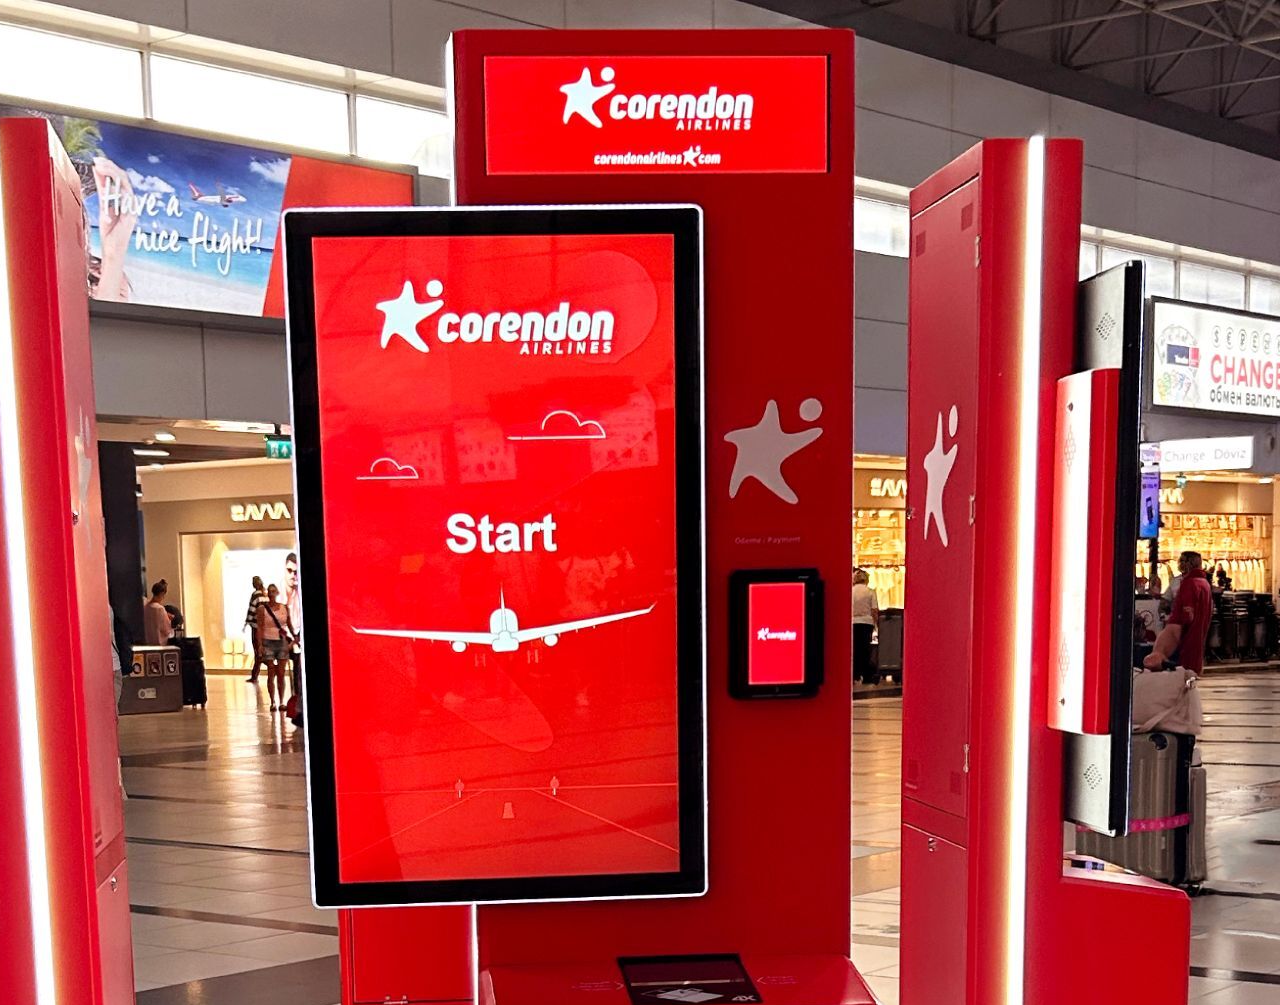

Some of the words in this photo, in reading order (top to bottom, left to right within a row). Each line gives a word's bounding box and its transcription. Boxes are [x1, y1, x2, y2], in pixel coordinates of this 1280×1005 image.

[609, 86, 754, 120] corendon
[676, 119, 752, 131] AIRLINES
[102, 175, 160, 217] Have
[166, 193, 183, 217] a
[135, 221, 181, 252] nice
[188, 211, 262, 276] flight!
[437, 302, 615, 343] corendon
[520, 341, 613, 355] AIRLINES
[1210, 385, 1242, 405] обмен
[1164, 451, 1206, 462] Change
[1214, 449, 1247, 460] Döviz
[446, 513, 557, 554] Start
